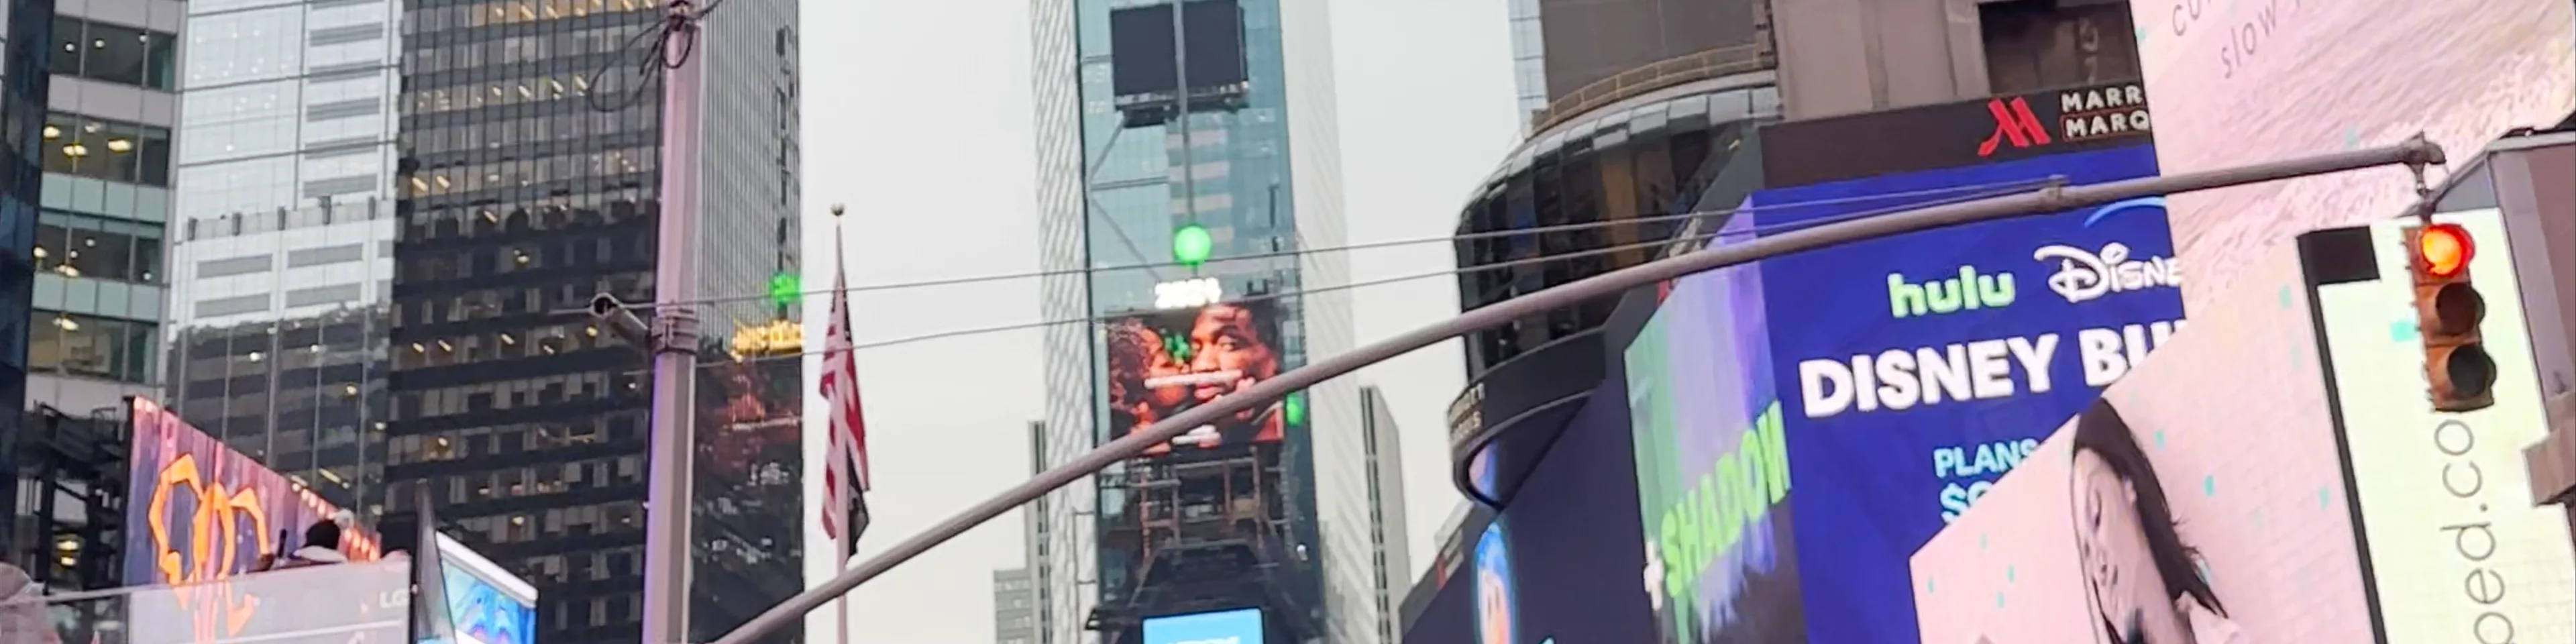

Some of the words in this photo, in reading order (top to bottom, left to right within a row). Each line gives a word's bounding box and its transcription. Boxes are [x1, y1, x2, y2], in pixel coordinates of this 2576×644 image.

[2220, 0, 2277, 79] slow
[2060, 85, 2143, 113] MARR
[1886, 265, 2016, 319] hulu
[1799, 333, 2059, 419] DISNEY
